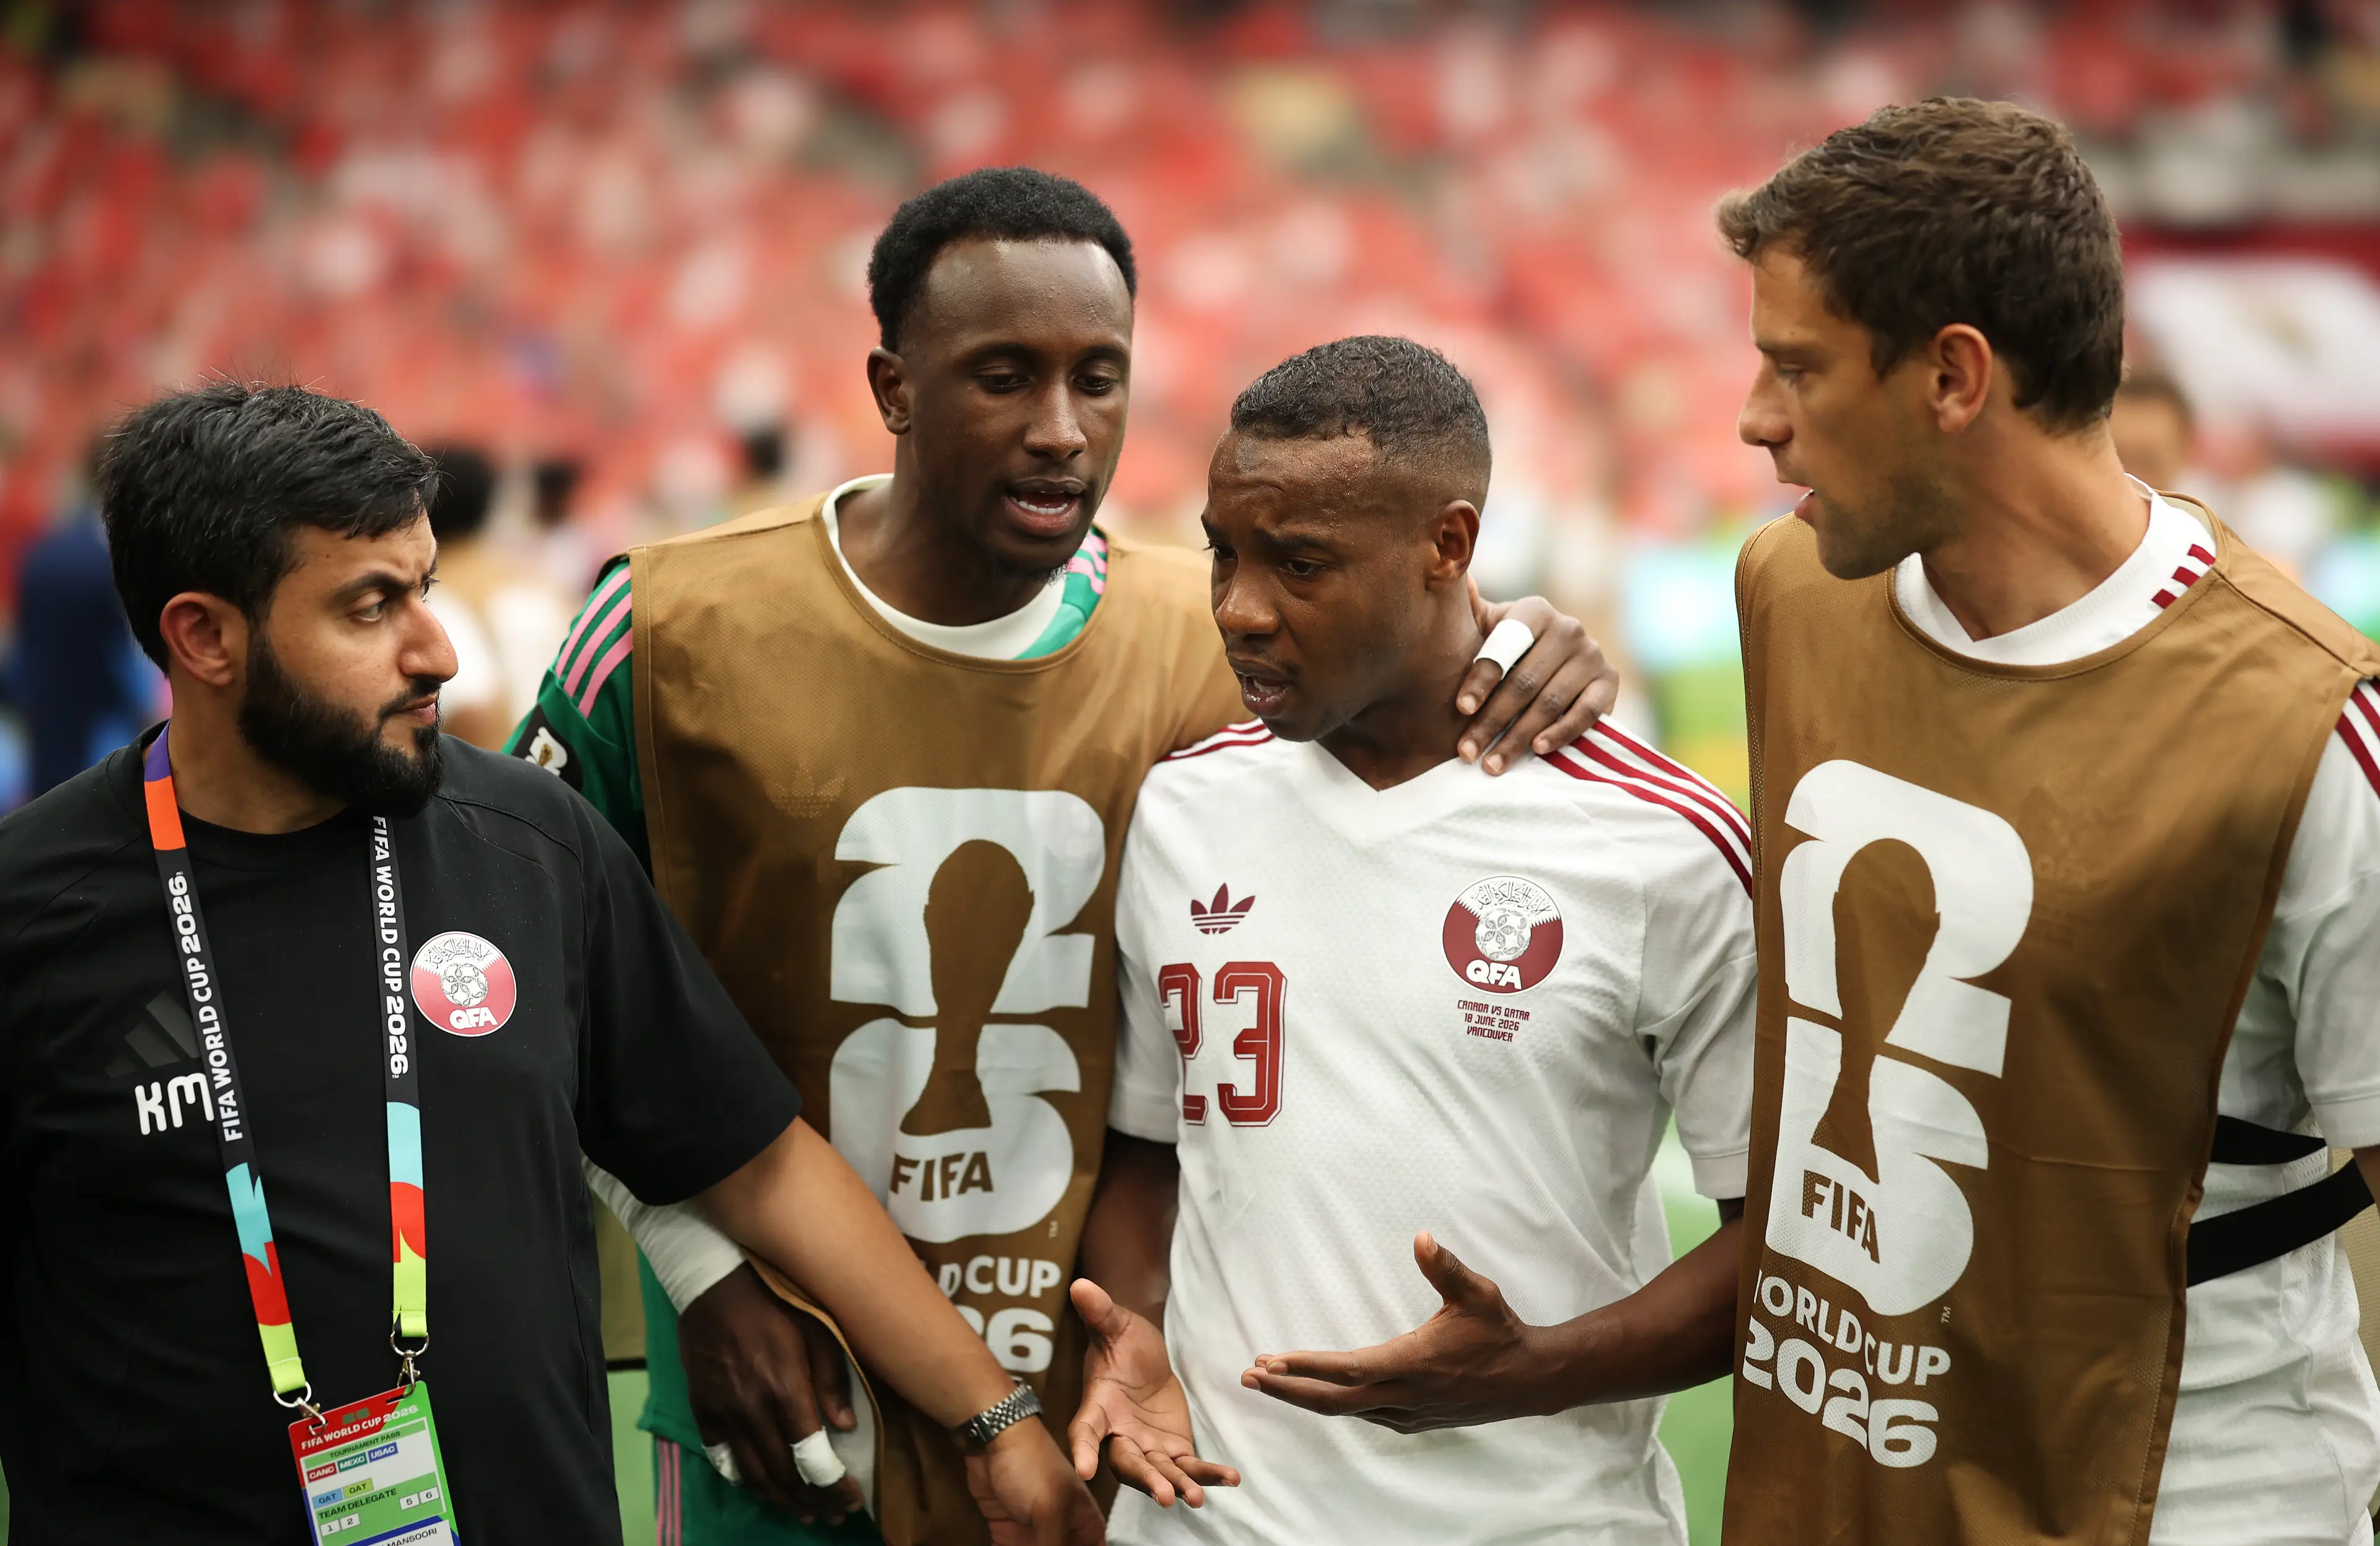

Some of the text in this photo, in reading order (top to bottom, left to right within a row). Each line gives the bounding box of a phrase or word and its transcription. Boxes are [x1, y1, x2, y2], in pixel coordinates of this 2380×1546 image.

[373, 815, 390, 861] FIFA
[168, 875, 201, 954] 2026
[376, 865, 399, 944] WORLD
[187, 958, 212, 1002] CUP
[382, 948, 402, 992] CUP
[1466, 959, 1523, 990] QFA
[449, 1006, 498, 1030] QFA
[1458, 1000, 1530, 1021] CANADA VS QATAR
[1465, 1013, 1520, 1031] 18 JUNE 2026
[198, 1005, 232, 1090] WORLD
[386, 996, 408, 1074] 2026
[1158, 961, 1287, 1127] 23
[1467, 1026, 1513, 1042] VANCOUVER
[134, 1072, 214, 1136] KM
[218, 1089, 243, 1142] FIFA
[889, 1151, 994, 1201] FIFA
[1801, 1169, 1880, 1264] FIFA
[964, 1255, 1061, 1298] CUP
[1865, 1331, 1951, 1386] CUP
[1742, 1315, 1939, 1468] 2026
[301, 1436, 324, 1451] FIFA
[324, 1423, 360, 1442] WORLD
[361, 1416, 382, 1429] CUP
[382, 1405, 419, 1423] 2026
[330, 1431, 401, 1459] TOURNAMENT PASS
[309, 1446, 395, 1480] CANC MEXC USAC
[319, 1483, 367, 1504] QAT QAT
[319, 1488, 397, 1519] TEAM DELEGATE
